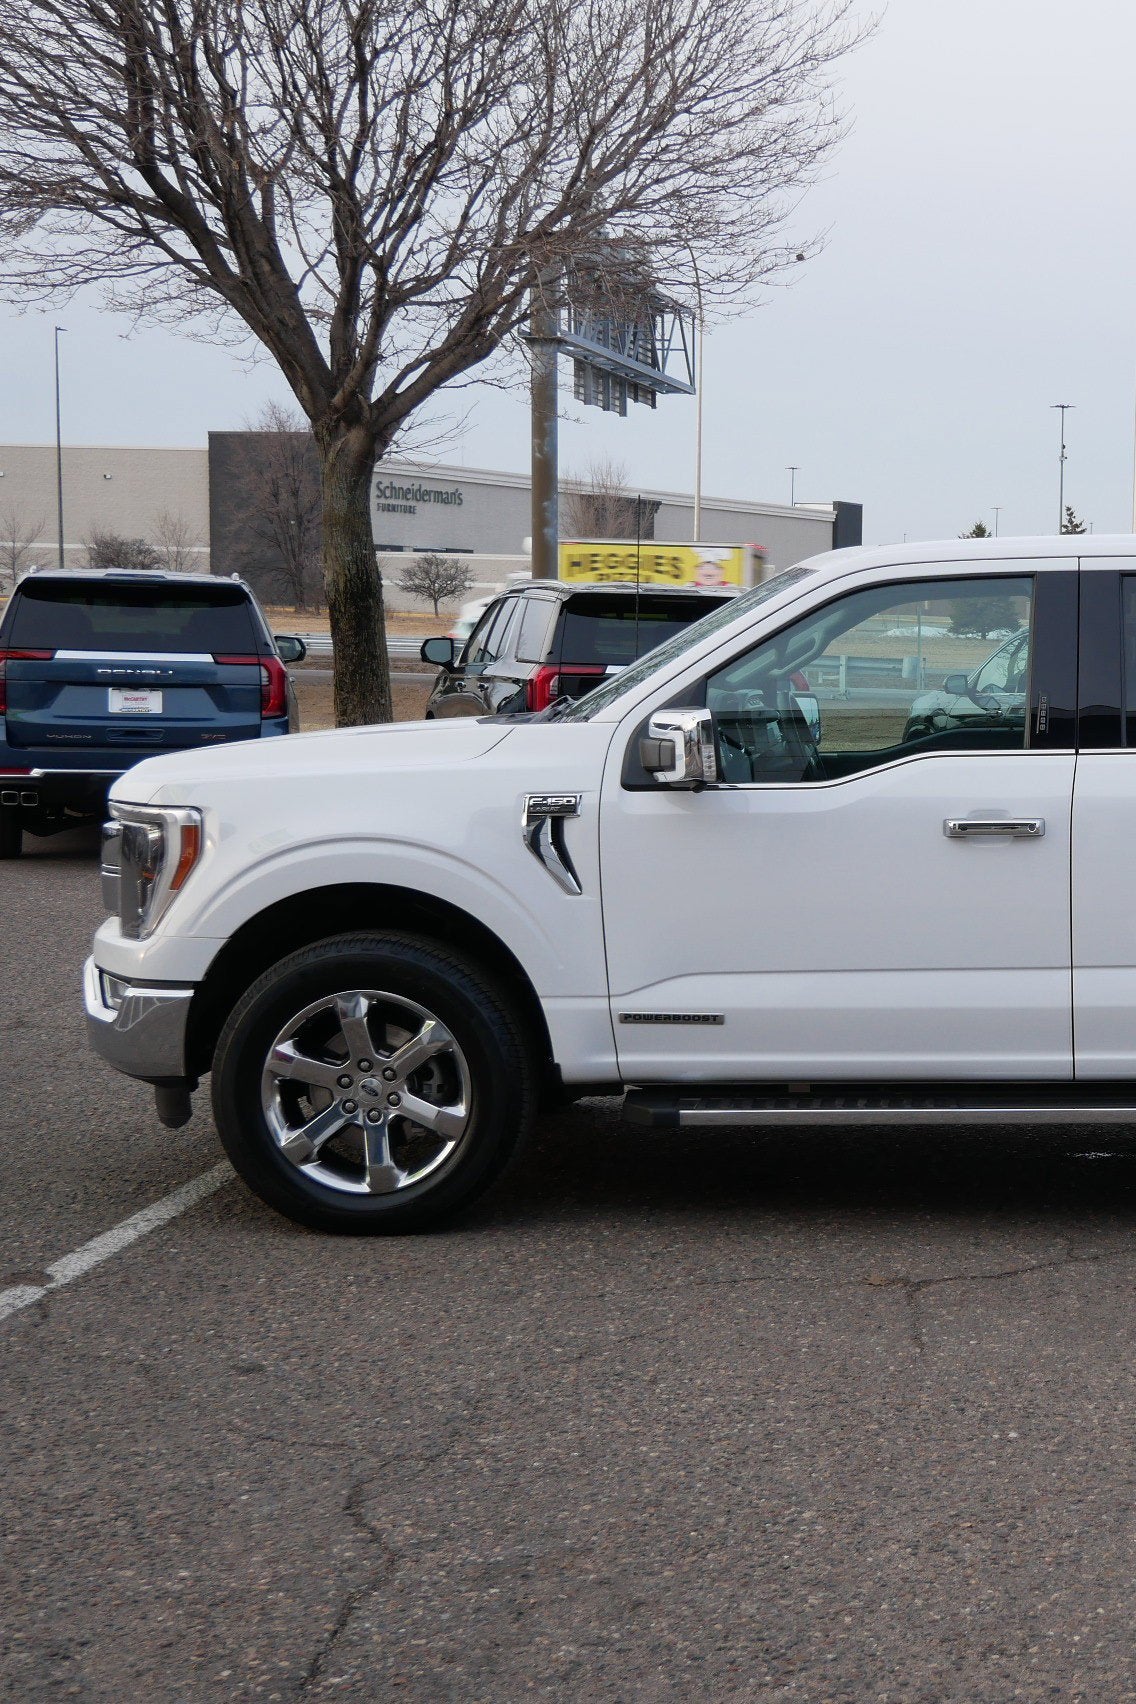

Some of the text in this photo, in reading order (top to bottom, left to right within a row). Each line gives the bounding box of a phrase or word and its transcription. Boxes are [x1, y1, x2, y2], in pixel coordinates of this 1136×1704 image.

[376, 480, 464, 506] Schneiderman's
[377, 502, 417, 514] FURNITURE
[566, 552, 683, 579] HEGGIES
[529, 797, 576, 806] F-150
[623, 1013, 720, 1022] POWERBOOST
